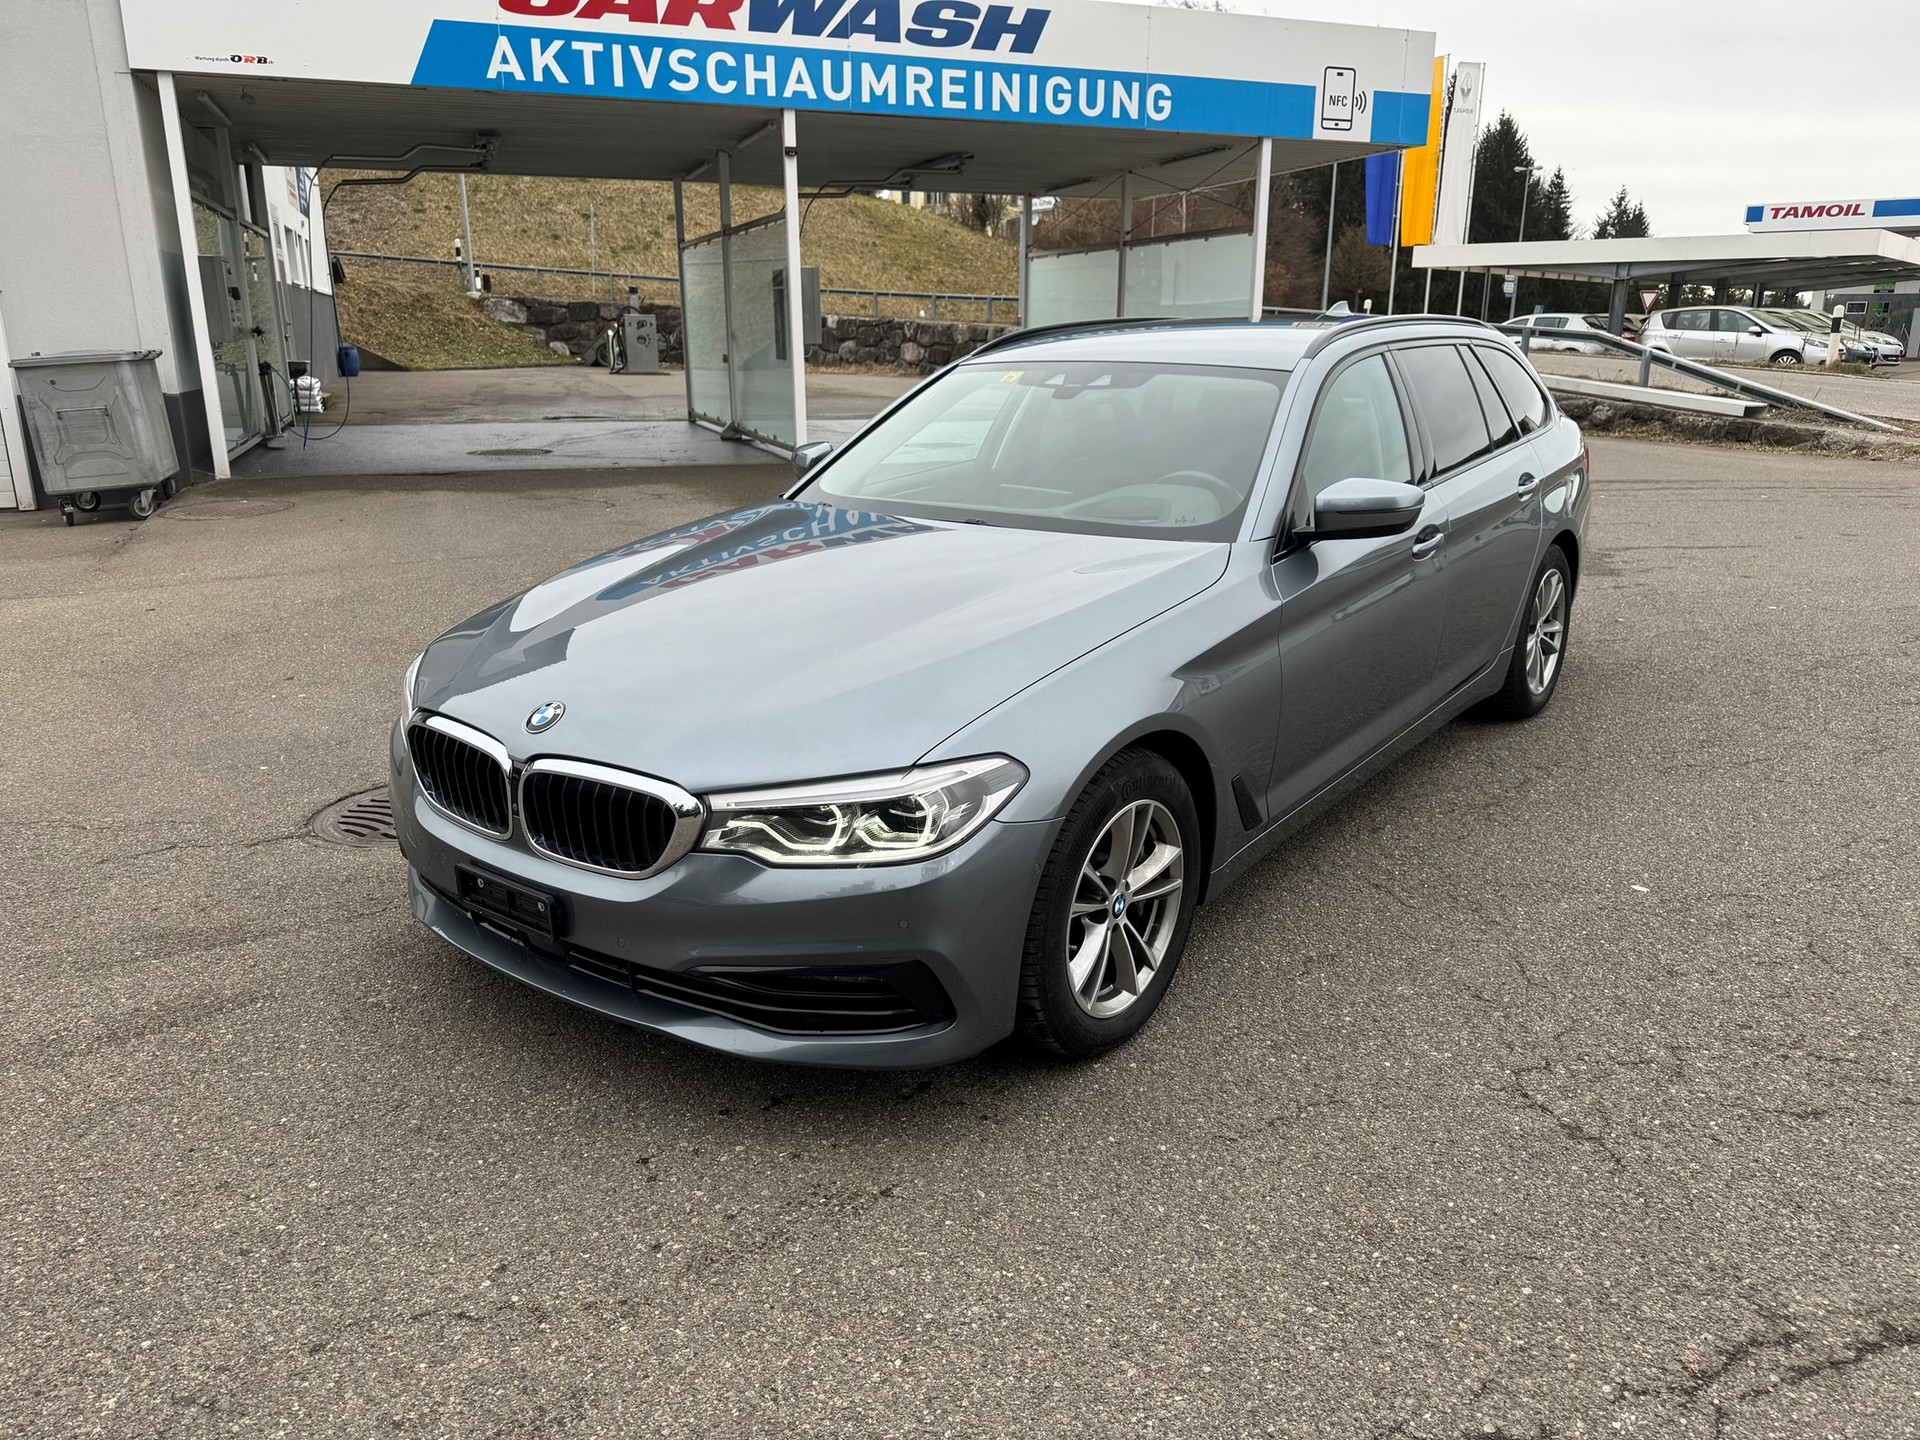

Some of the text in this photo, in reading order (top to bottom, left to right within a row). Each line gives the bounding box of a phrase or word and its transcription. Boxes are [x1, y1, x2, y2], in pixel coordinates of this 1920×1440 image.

[486, 35, 1173, 121] AKTIVSCHAUMREINIGUNG
[1328, 95, 1348, 107] NFC
[1770, 203, 1866, 219] TAMOIL
